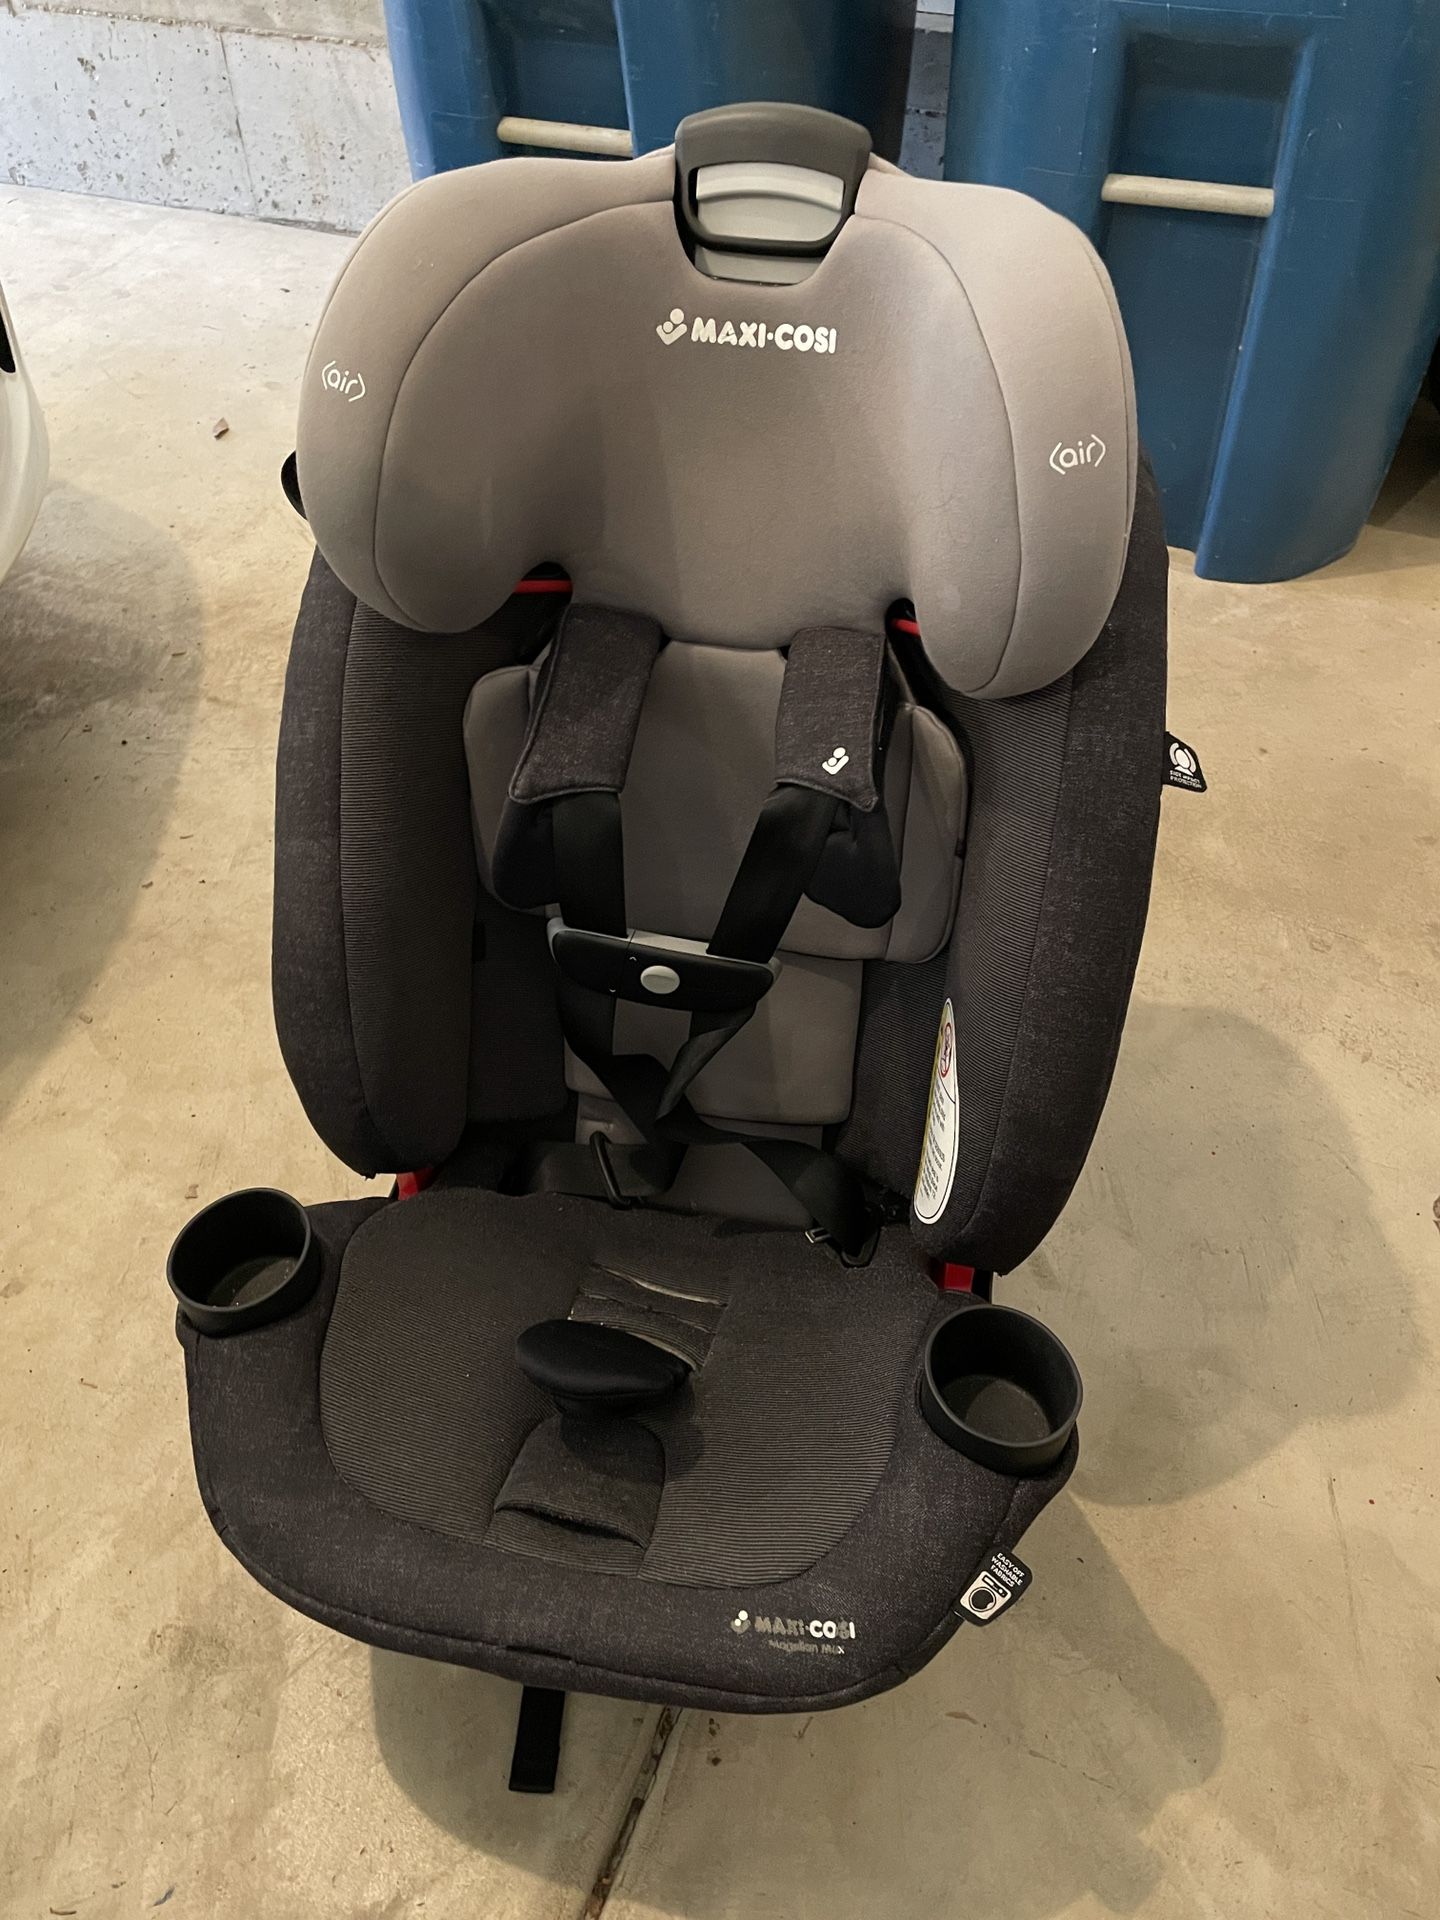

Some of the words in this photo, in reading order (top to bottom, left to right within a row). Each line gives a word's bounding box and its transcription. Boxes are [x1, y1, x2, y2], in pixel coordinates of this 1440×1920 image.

[990, 1564, 1016, 1588] FABRICS
[991, 1555, 1023, 1586] WASHABLE
[996, 1552, 1015, 1569] EASY
[1012, 1566, 1025, 1578] OFF
